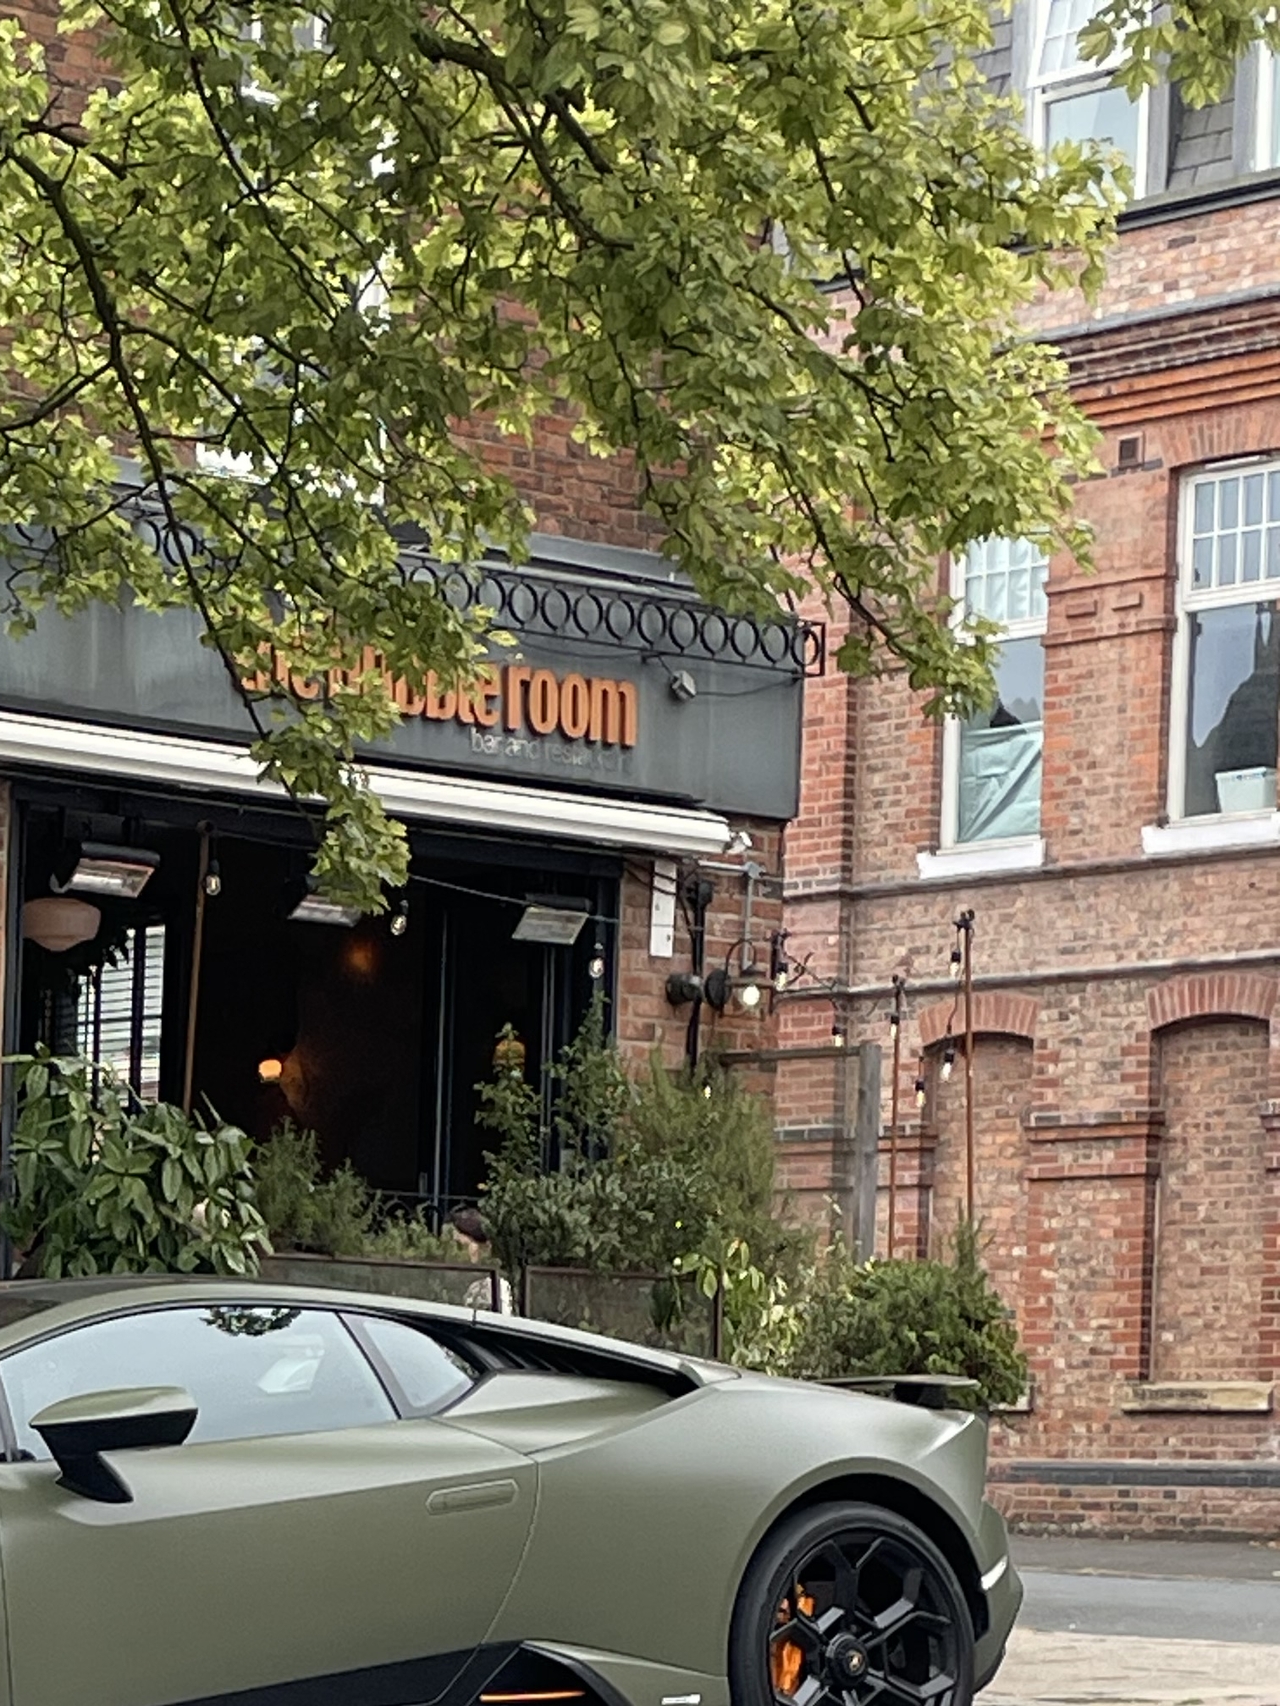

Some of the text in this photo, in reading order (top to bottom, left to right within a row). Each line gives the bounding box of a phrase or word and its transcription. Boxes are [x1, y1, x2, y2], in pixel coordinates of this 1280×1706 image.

[505, 664, 637, 746] room
[470, 728, 503, 753] bar
[505, 737, 540, 760] and
